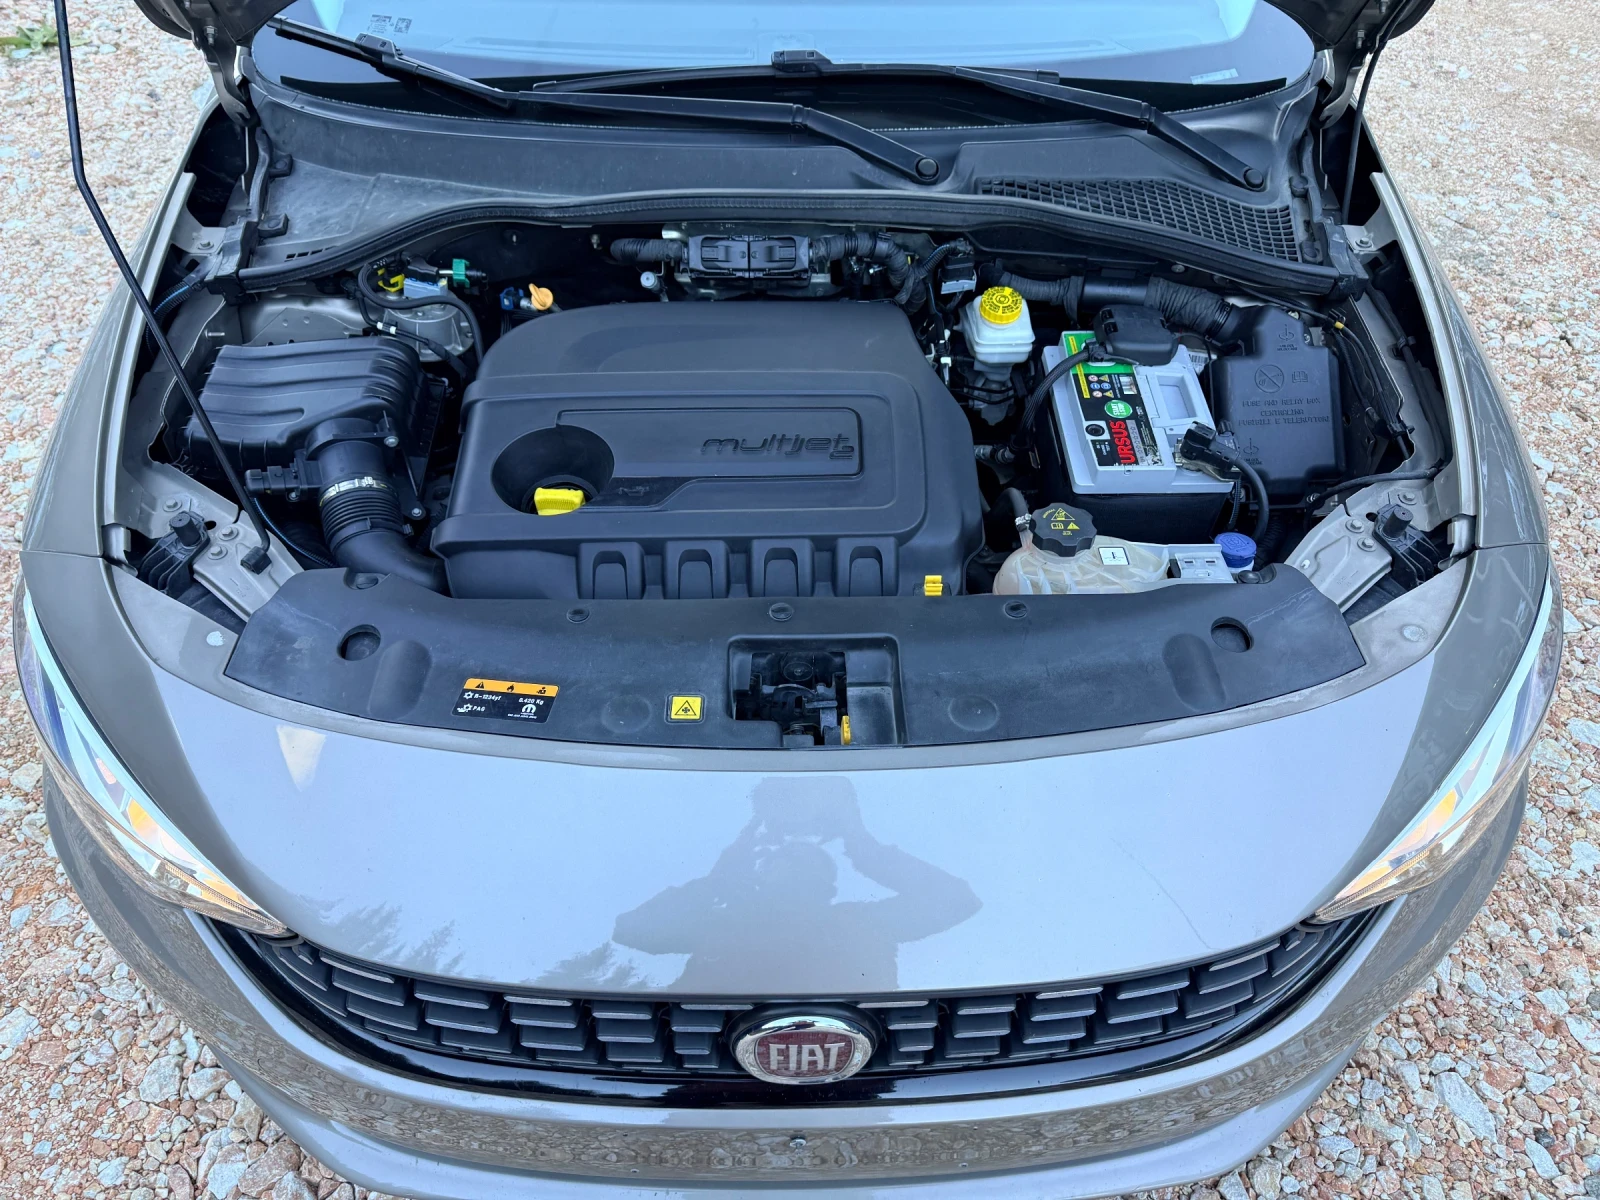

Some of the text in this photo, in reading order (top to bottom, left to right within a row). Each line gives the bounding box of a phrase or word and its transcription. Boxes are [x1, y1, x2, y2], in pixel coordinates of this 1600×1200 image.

[1264, 399, 1278, 407] AND
[1281, 398, 1304, 406] RELAY
[702, 433, 850, 456] multijet
[1110, 420, 1136, 464] URSUS
[769, 1042, 846, 1071] FIAT
